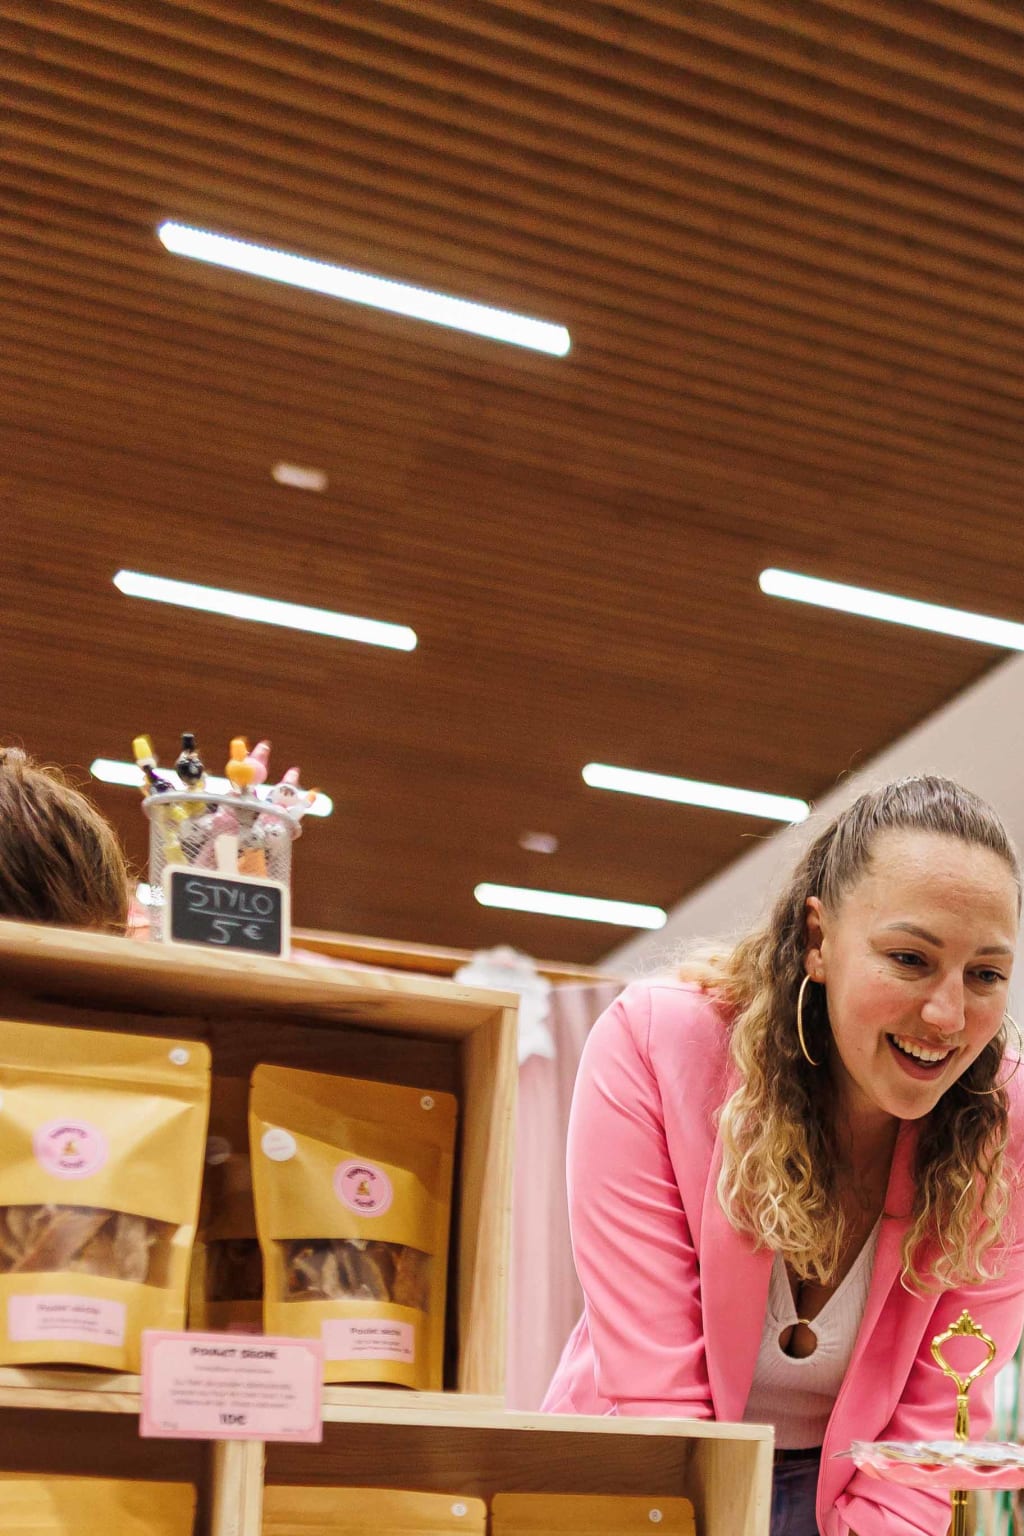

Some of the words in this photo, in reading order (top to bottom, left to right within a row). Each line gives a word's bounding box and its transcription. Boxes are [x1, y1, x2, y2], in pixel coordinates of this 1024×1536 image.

[185, 881, 274, 915] STYLO
[209, 920, 242, 944] 5
[242, 925, 264, 940] €
